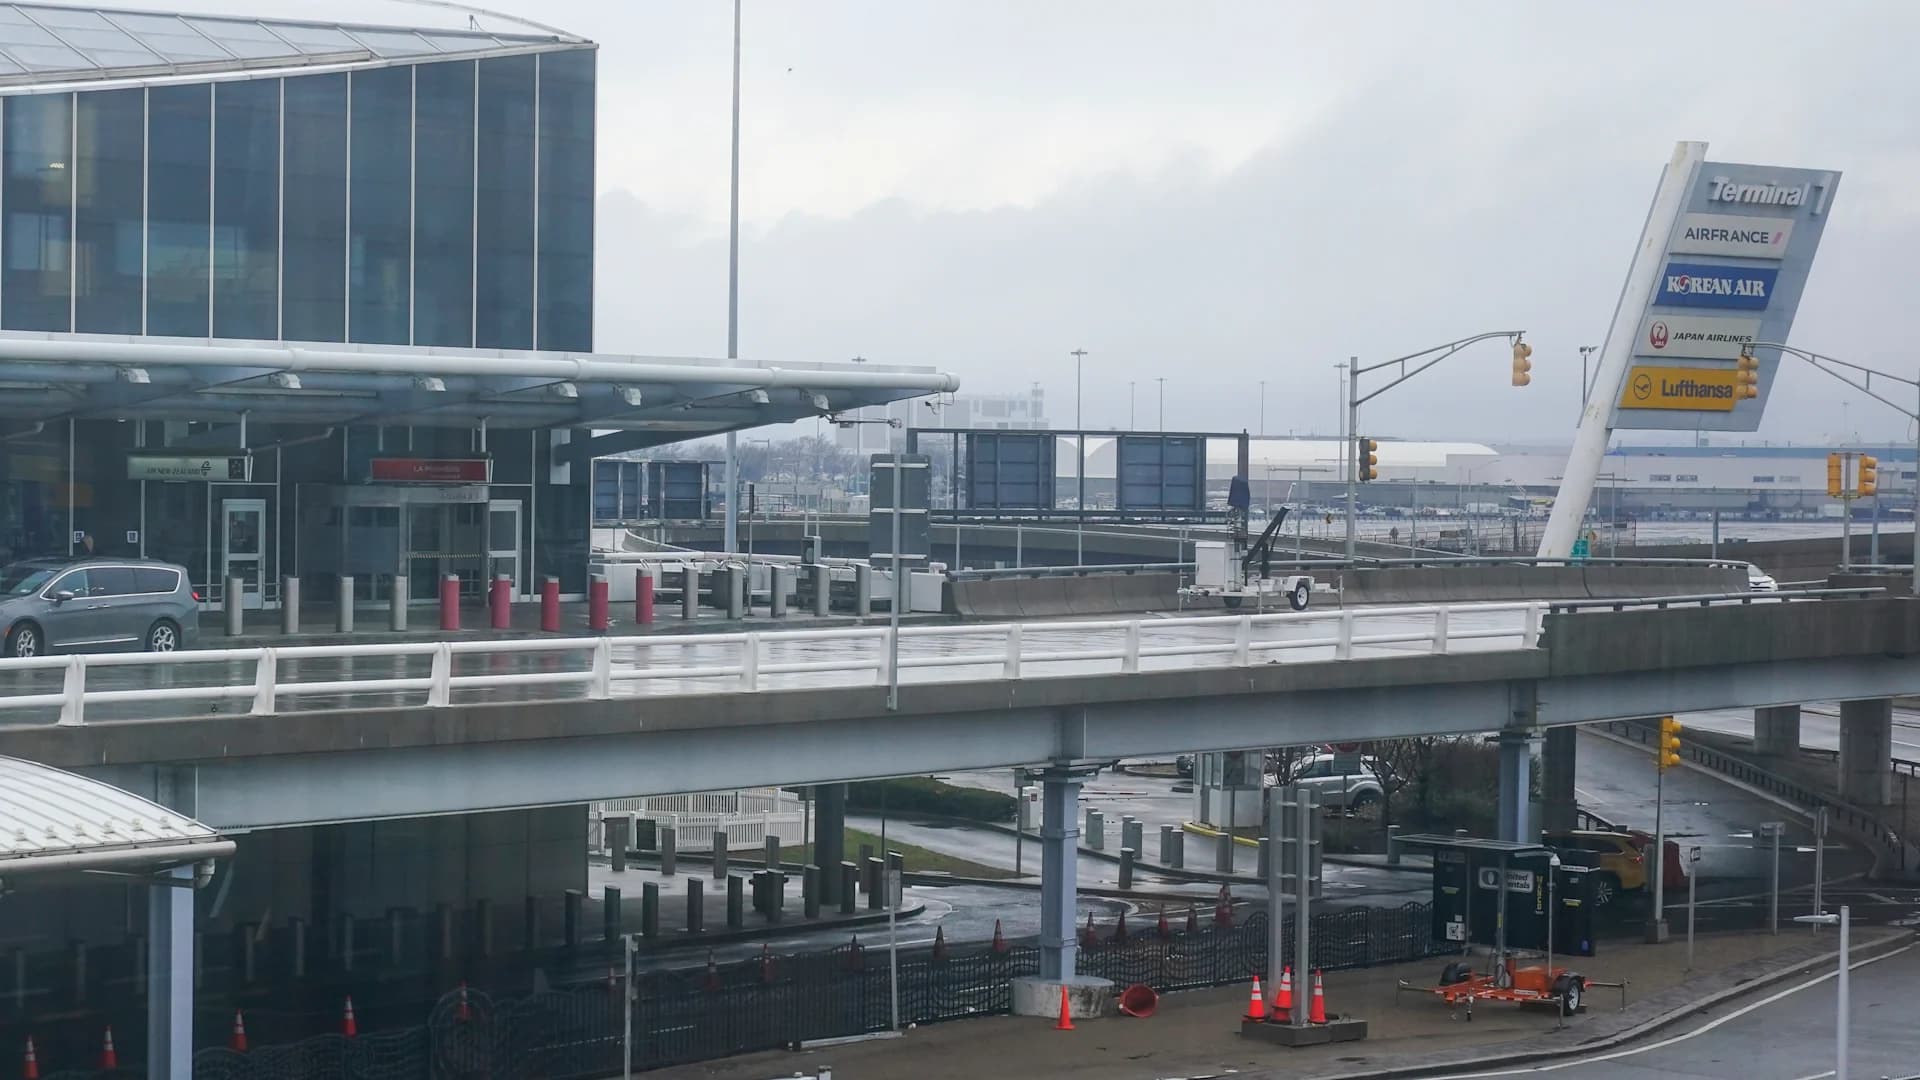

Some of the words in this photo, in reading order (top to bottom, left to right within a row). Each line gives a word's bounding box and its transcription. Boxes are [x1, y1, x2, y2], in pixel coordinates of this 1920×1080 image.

[1710, 175, 1810, 206] Terminal
[1813, 173, 1834, 216] 1
[1685, 228, 1769, 244] AIRFRANCE
[1667, 275, 1732, 295] KOREAN
[1734, 279, 1765, 297] AIR
[1673, 332, 1704, 341] JAPAN
[1706, 334, 1752, 342] AIRLINES
[1662, 379, 1733, 398] Lufthansa
